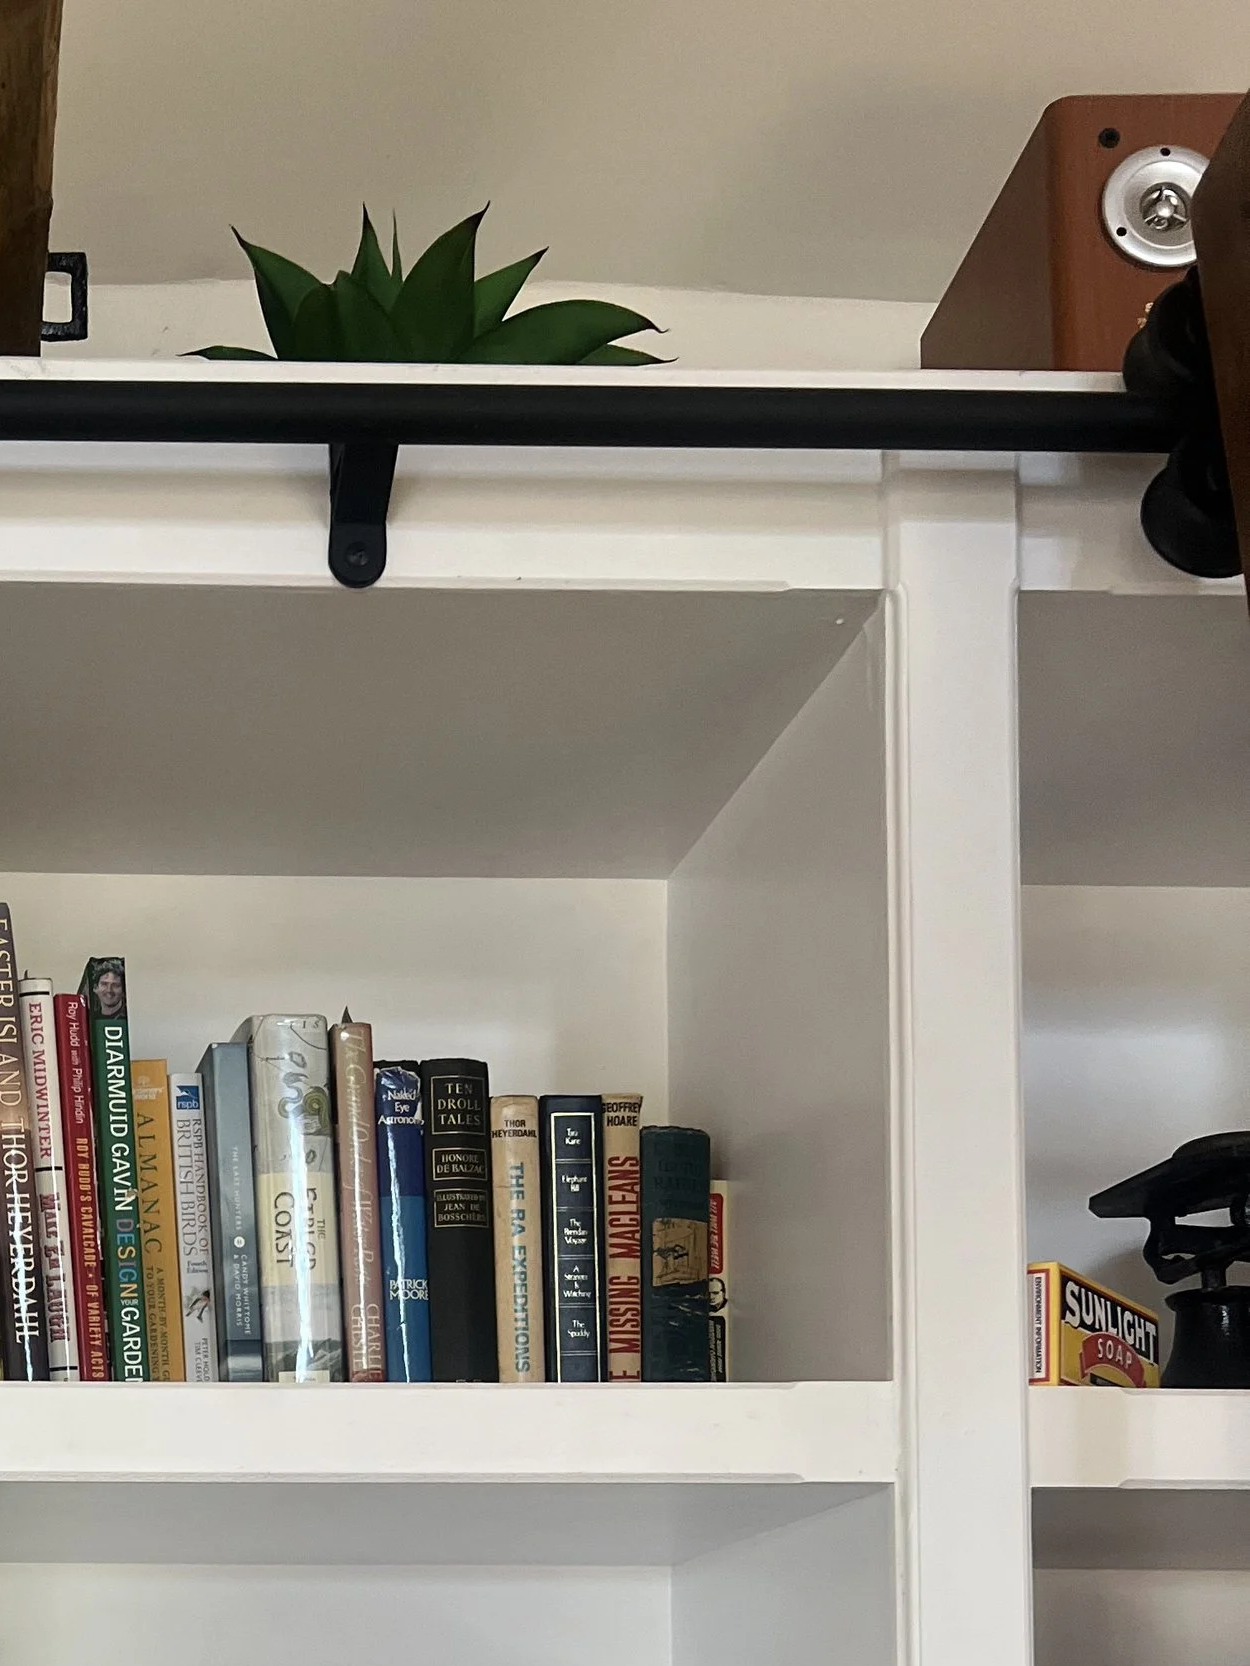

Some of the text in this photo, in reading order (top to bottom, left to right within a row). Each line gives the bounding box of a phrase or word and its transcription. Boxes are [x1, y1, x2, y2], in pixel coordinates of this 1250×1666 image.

[66, 1001, 79, 1020] Roy
[68, 1022, 81, 1048] Hudd
[29, 1002, 52, 1160] ERIC MIDWINTER
[72, 1067, 84, 1093] Philip
[445, 1083, 473, 1095] TEN
[177, 1100, 200, 1110] rspb
[387, 1087, 416, 1101] Naked
[437, 1099, 482, 1111] DROLL
[104, 1026, 134, 1211] DIARMUID GAVIN
[394, 1102, 411, 1113] Eye
[437, 1113, 481, 1125] TALES
[602, 1101, 642, 1114] GEOFFREY
[491, 1129, 538, 1138] HEYERDAHL
[504, 1119, 526, 1128] THOR
[606, 1115, 638, 1127] HOARE
[436, 1164, 485, 1174] DE BALZAC
[137, 1113, 162, 1254] ALMANAC
[176, 1119, 199, 1257] BRITISH BIRDS
[192, 1118, 209, 1256] RSPB HANDBOOK OF
[443, 1203, 466, 1211] JEAN
[607, 1156, 641, 1259] MACLEANS
[0, 1117, 40, 1344] THOR HEYERDAHL
[274, 1191, 295, 1268] COAST
[316, 1219, 327, 1241] THE
[76, 1138, 105, 1379] ROY HUDD'S CAVALCADE OF VARIETY ACTS
[116, 1218, 139, 1299] DESIGN
[509, 1162, 531, 1374] THE RA EXPEDITIONS
[146, 1266, 155, 1281] TO
[389, 1279, 428, 1290] PATRICK
[147, 1283, 157, 1310] YOUR
[389, 1289, 429, 1300] MOORE
[572, 1319, 585, 1328] The
[608, 1275, 641, 1353] MISSING
[1065, 1281, 1156, 1364] SUNLIGHT
[149, 1313, 160, 1375] GARDENING
[365, 1303, 382, 1379] CHARLIE
[1097, 1338, 1132, 1366] SOAP
